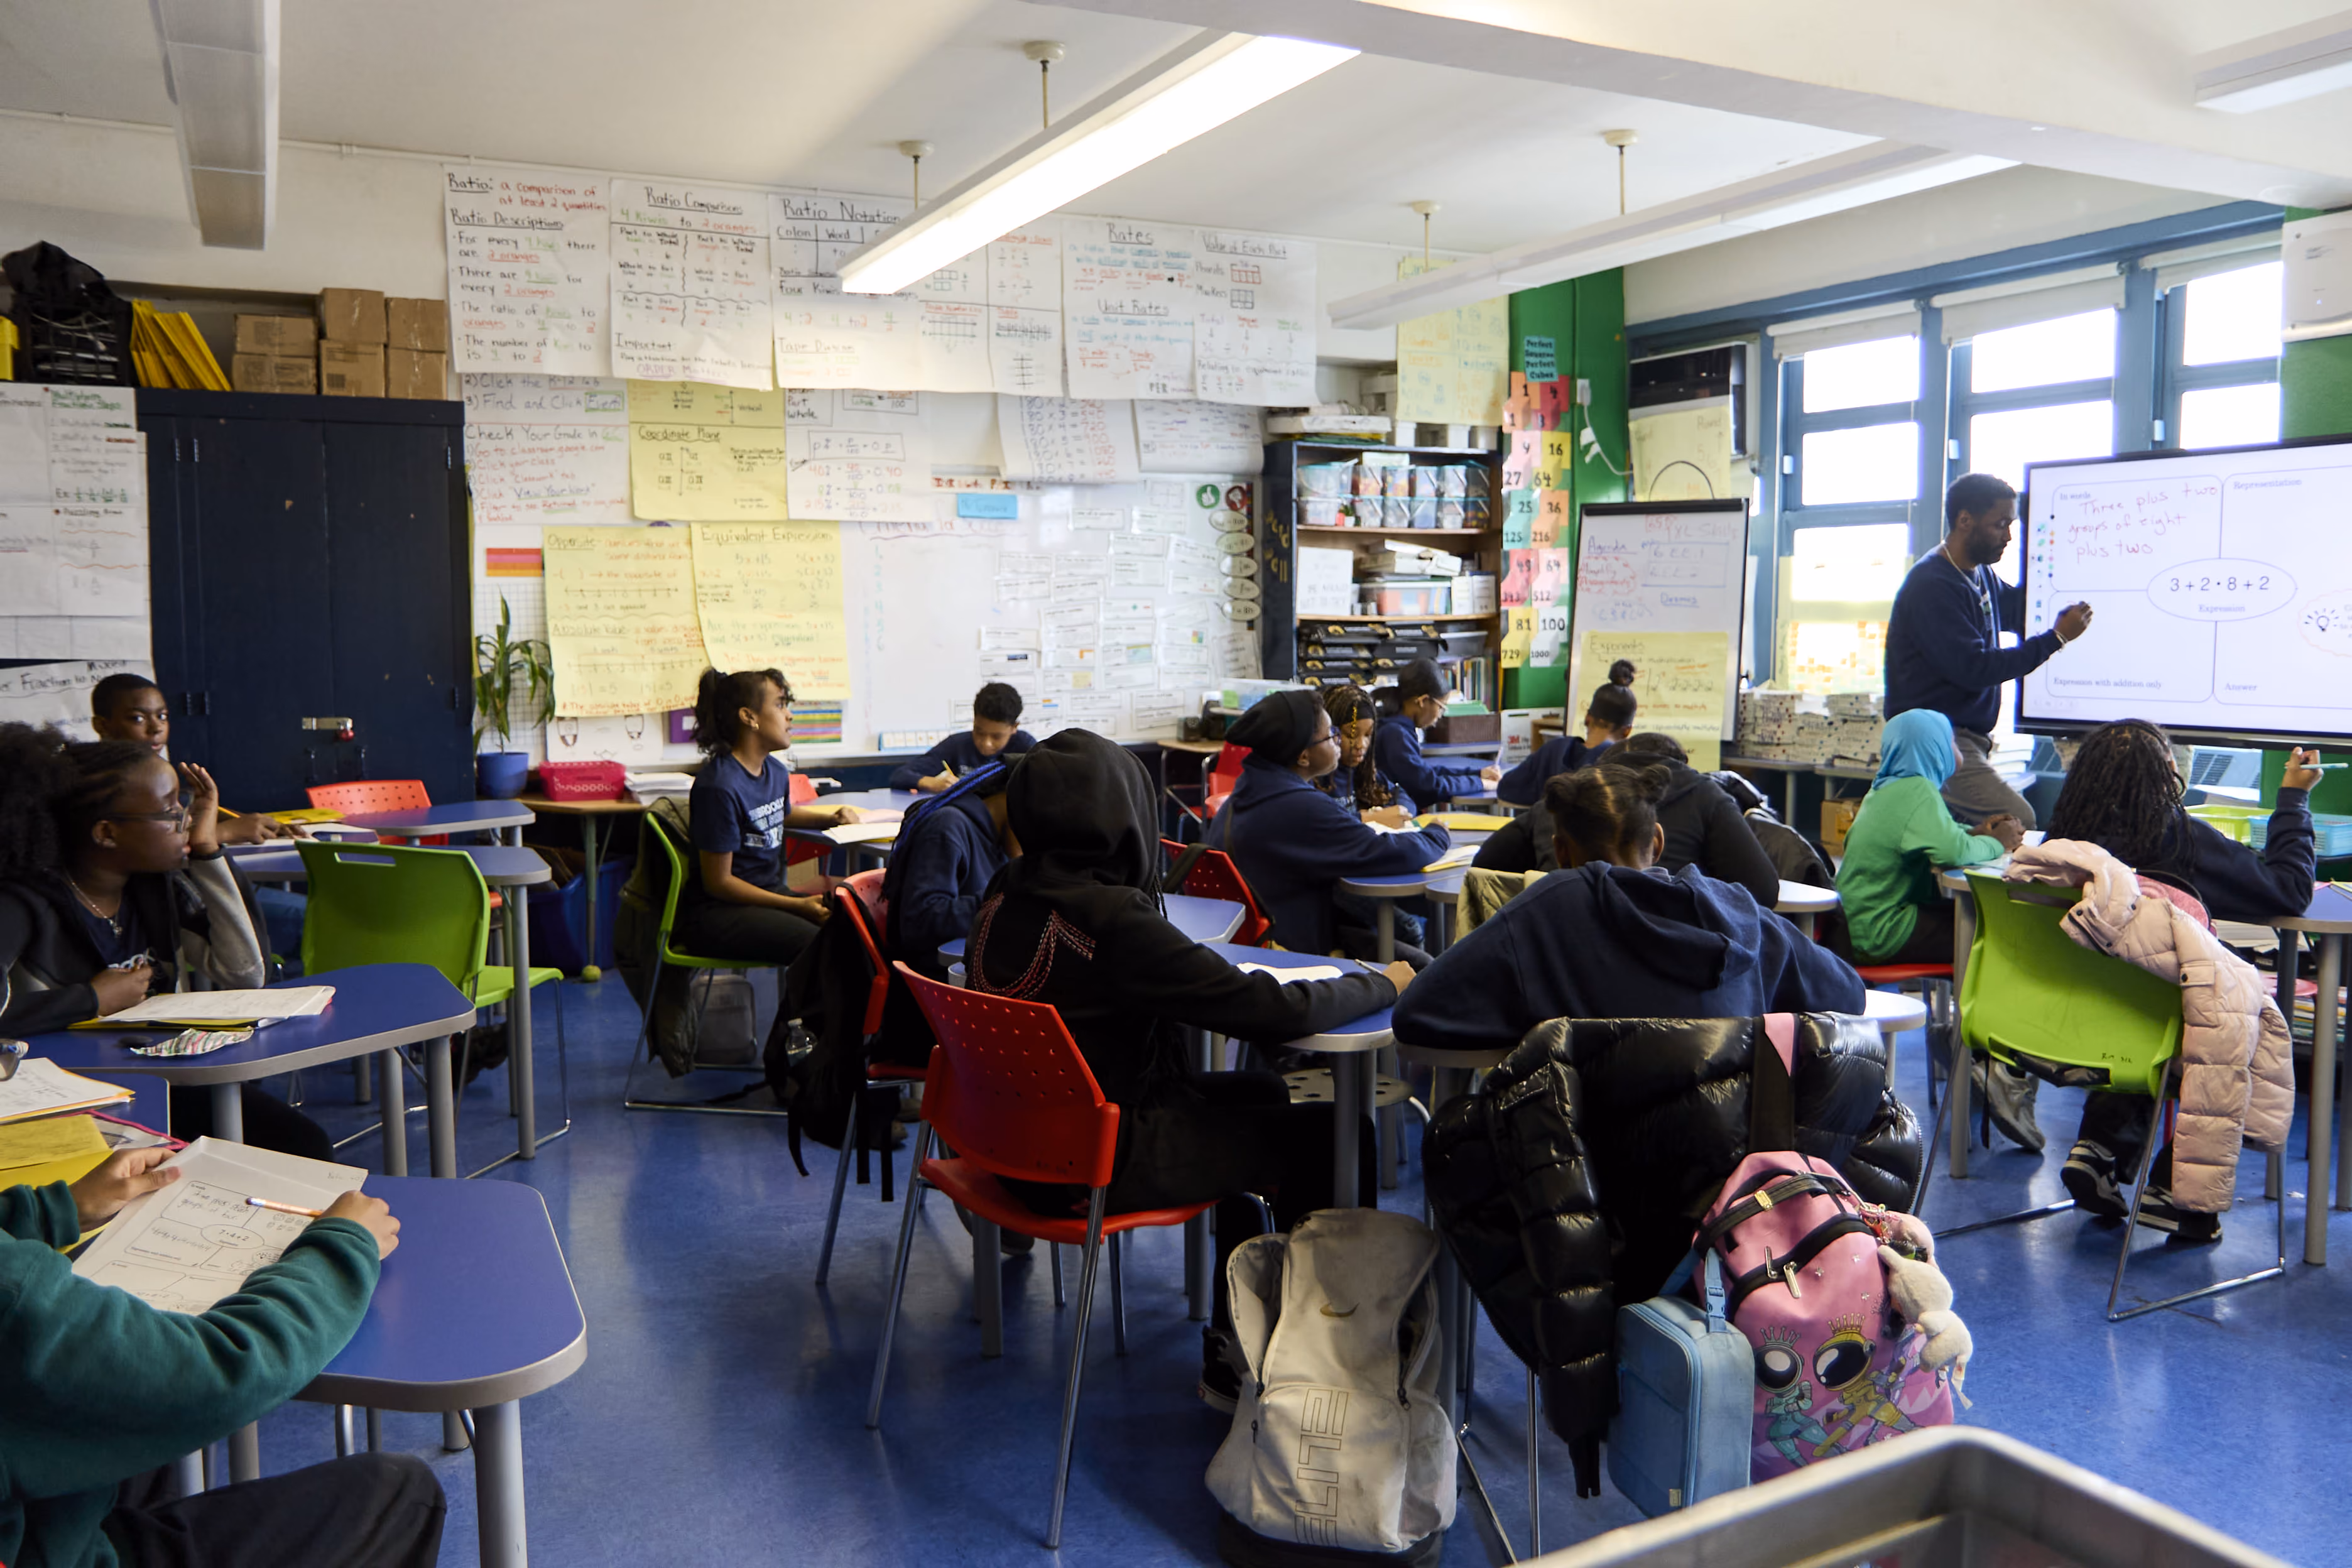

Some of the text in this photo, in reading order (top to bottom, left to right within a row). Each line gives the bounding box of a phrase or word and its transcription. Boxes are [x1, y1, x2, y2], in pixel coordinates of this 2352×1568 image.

[501, 182, 511, 190] a
[517, 182, 576, 196] comparison
[584, 187, 597, 195] of
[499, 197, 512, 205] at
[521, 196, 545, 207] least
[551, 197, 558, 207] 2
[450, 208, 487, 223] Ratio
[784, 199, 827, 219] Ratio
[459, 266, 491, 278] There
[1526, 339, 1553, 349] Perfect
[1530, 371, 1554, 379] Cubes
[1523, 384, 1557, 400] 1 4
[1510, 413, 1515, 426] 1
[465, 424, 514, 440] Check
[1549, 444, 1563, 455] 16
[1504, 472, 1551, 487] 27 64
[2233, 479, 2302, 491] Representation
[2079, 482, 2218, 515] Three plus two
[1518, 501, 1561, 513] 25 36
[2068, 513, 2187, 543] groups of eight
[1505, 532, 1550, 543] 125 216
[2076, 541, 2153, 565] plus two
[1546, 560, 1560, 571] 64
[2170, 579, 2180, 592] 3
[2201, 577, 2211, 591] 2
[2227, 577, 2237, 591] 8
[2259, 576, 2270, 591] 2
[1533, 591, 1551, 601] 512
[2198, 604, 2246, 614] Expression
[1516, 618, 1565, 631] 81 100
[1502, 649, 1550, 659] 729 1000
[2054, 677, 2163, 690] Expression with addition only
